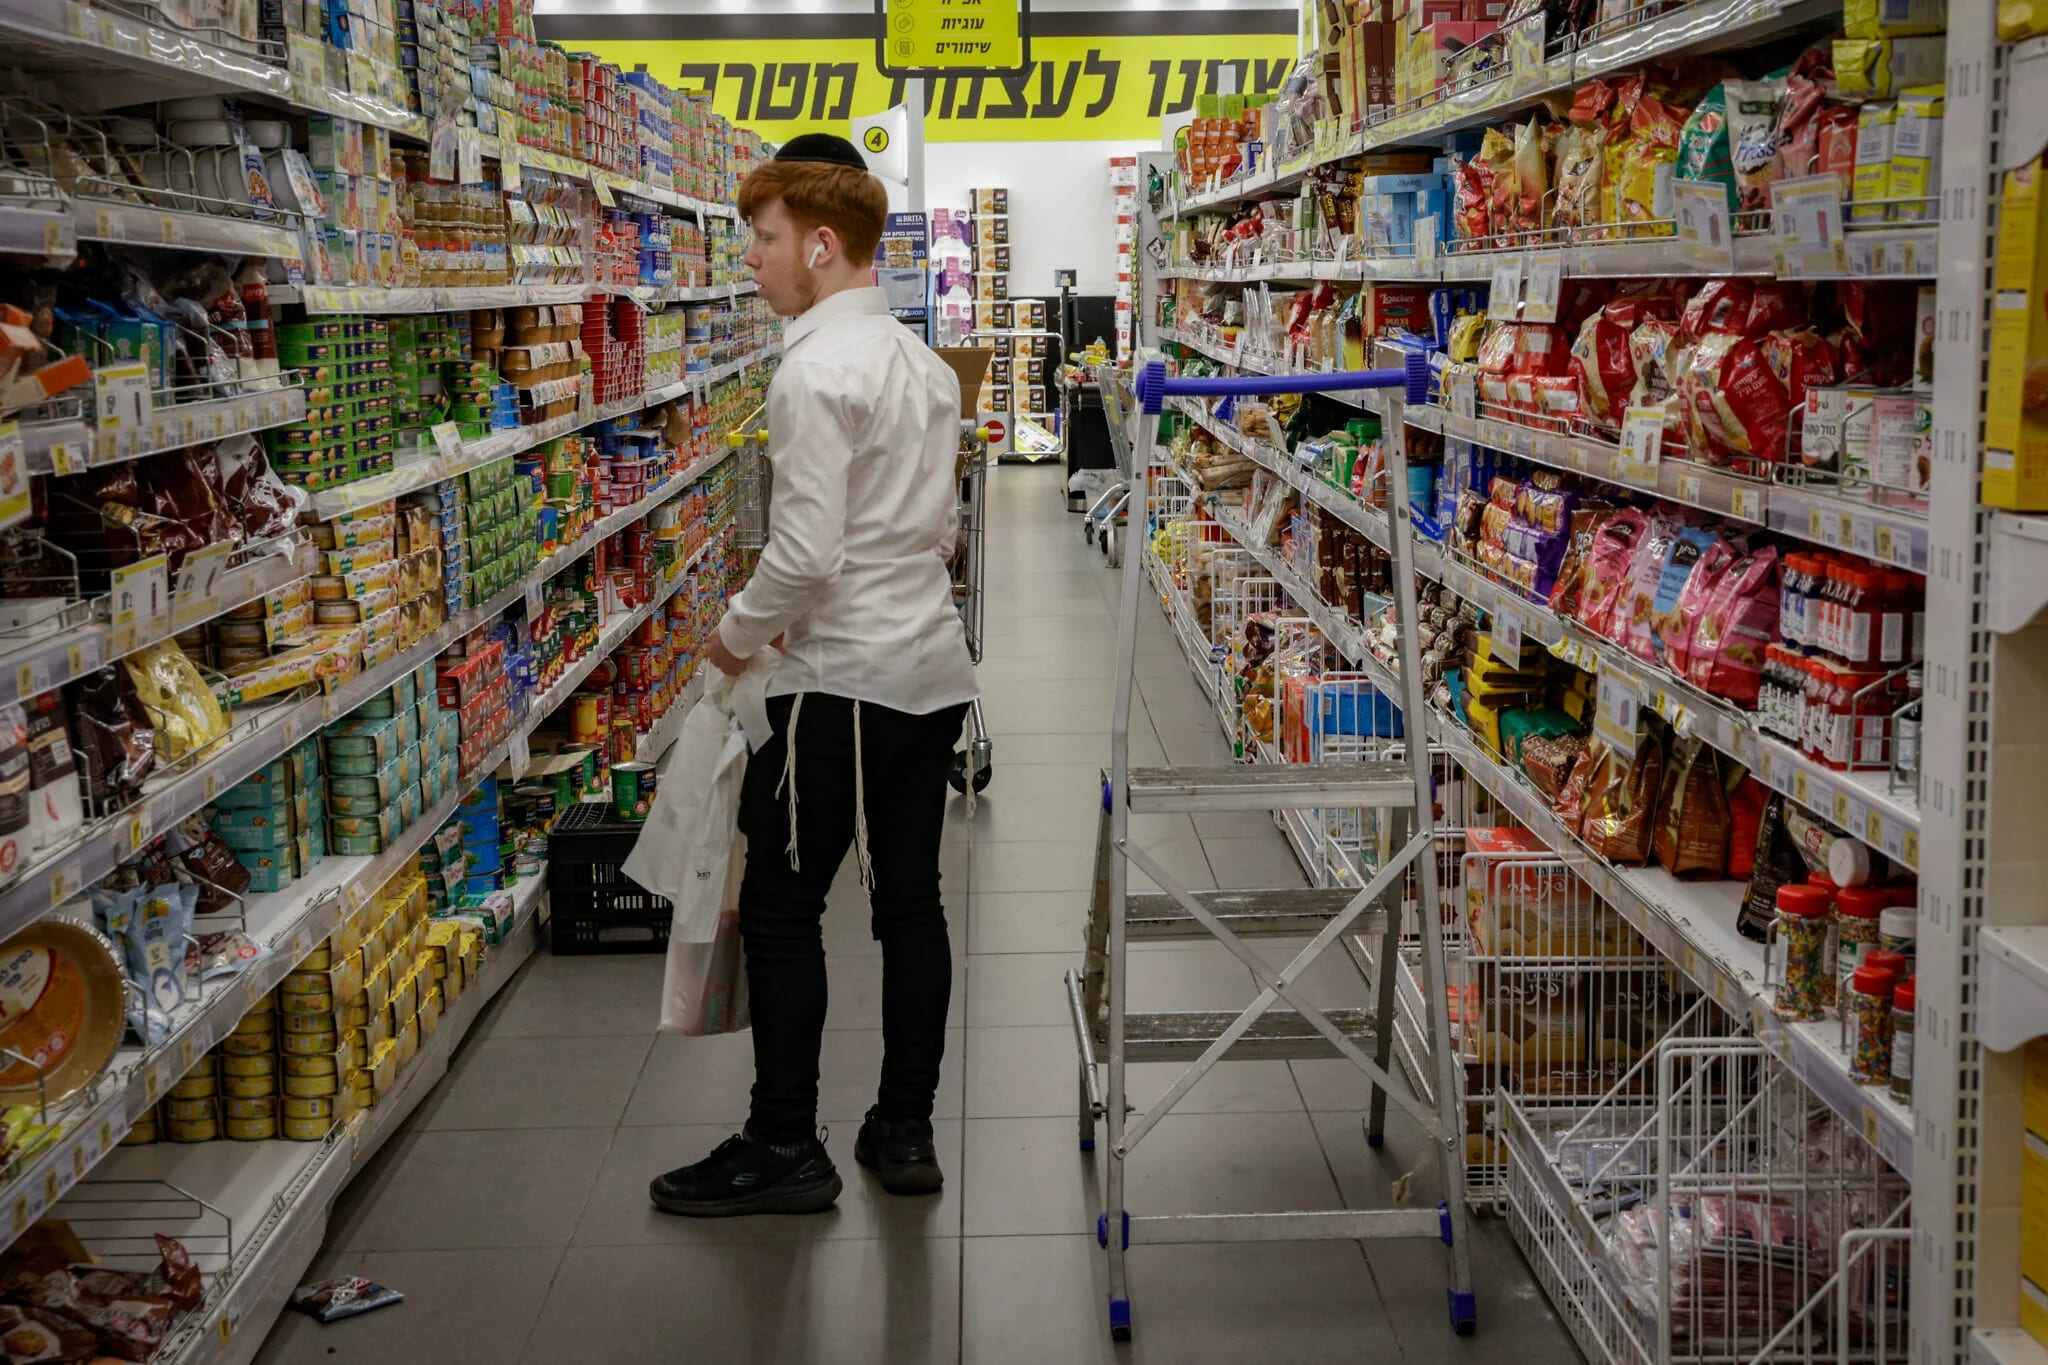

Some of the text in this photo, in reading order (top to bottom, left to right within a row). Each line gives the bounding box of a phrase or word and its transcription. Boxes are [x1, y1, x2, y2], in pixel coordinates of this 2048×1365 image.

[941, 17, 984, 30] עוגיות
[936, 41, 991, 54] שימורים
[870, 132, 882, 147] 4
[903, 214, 924, 222] BRITA
[1379, 293, 1416, 305] Loacker
